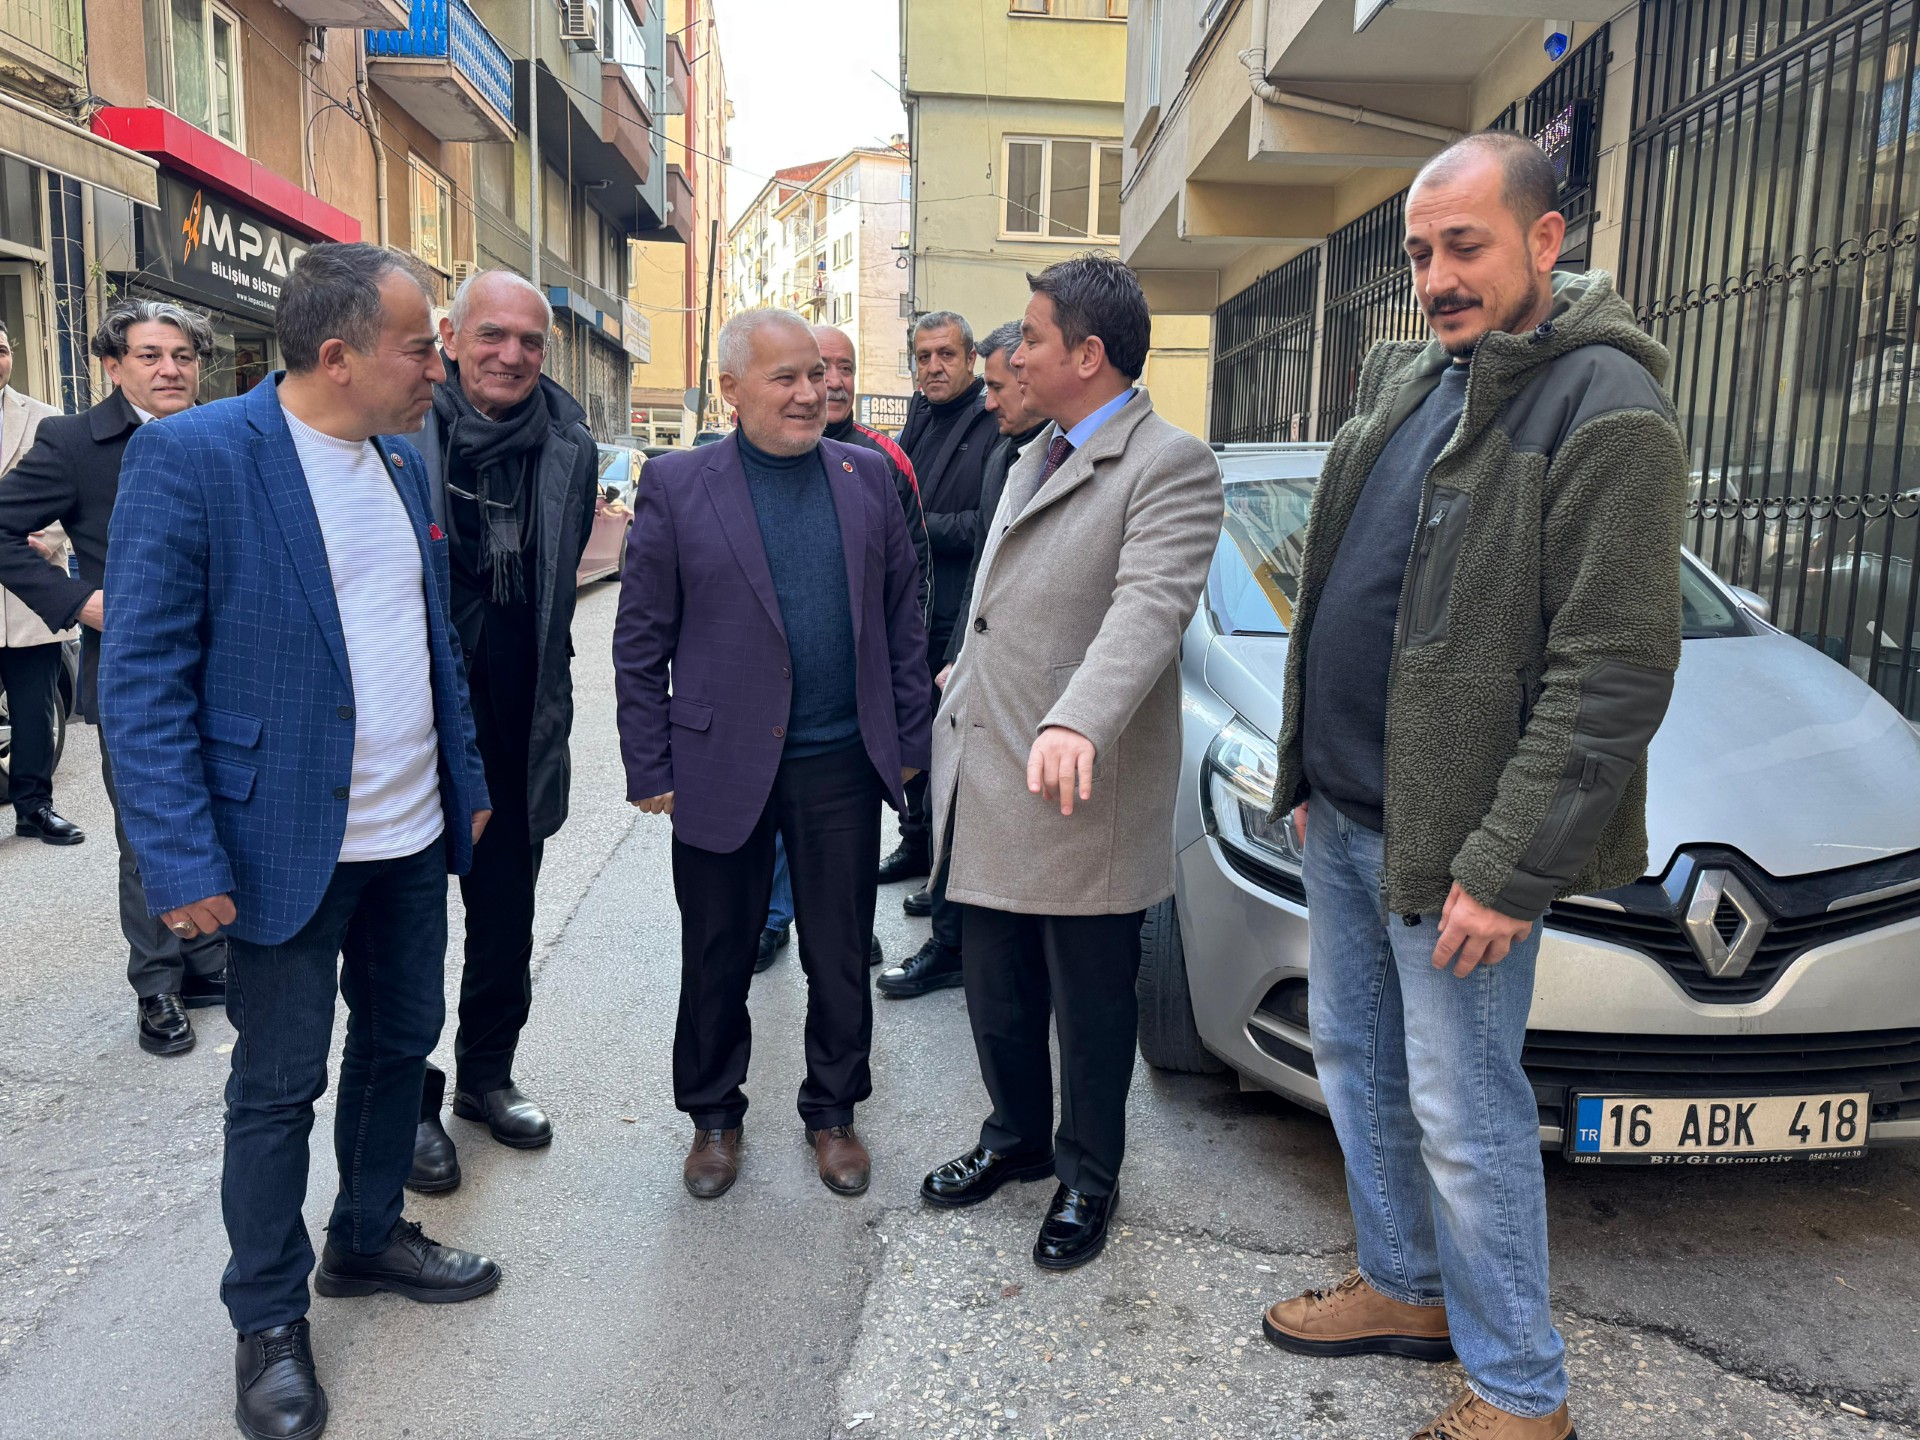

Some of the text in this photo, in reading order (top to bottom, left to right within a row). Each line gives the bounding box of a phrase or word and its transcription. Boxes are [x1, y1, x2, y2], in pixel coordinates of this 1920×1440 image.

[211, 261, 250, 286] BİLİŞİM
[871, 398, 908, 414] BASKI
[1610, 1098, 1858, 1147] 16 ABK 418
[1579, 1128, 1599, 1142] TR
[1574, 1156, 1601, 1164] BURSA
[1715, 1154, 1792, 1165] Otomotiv
